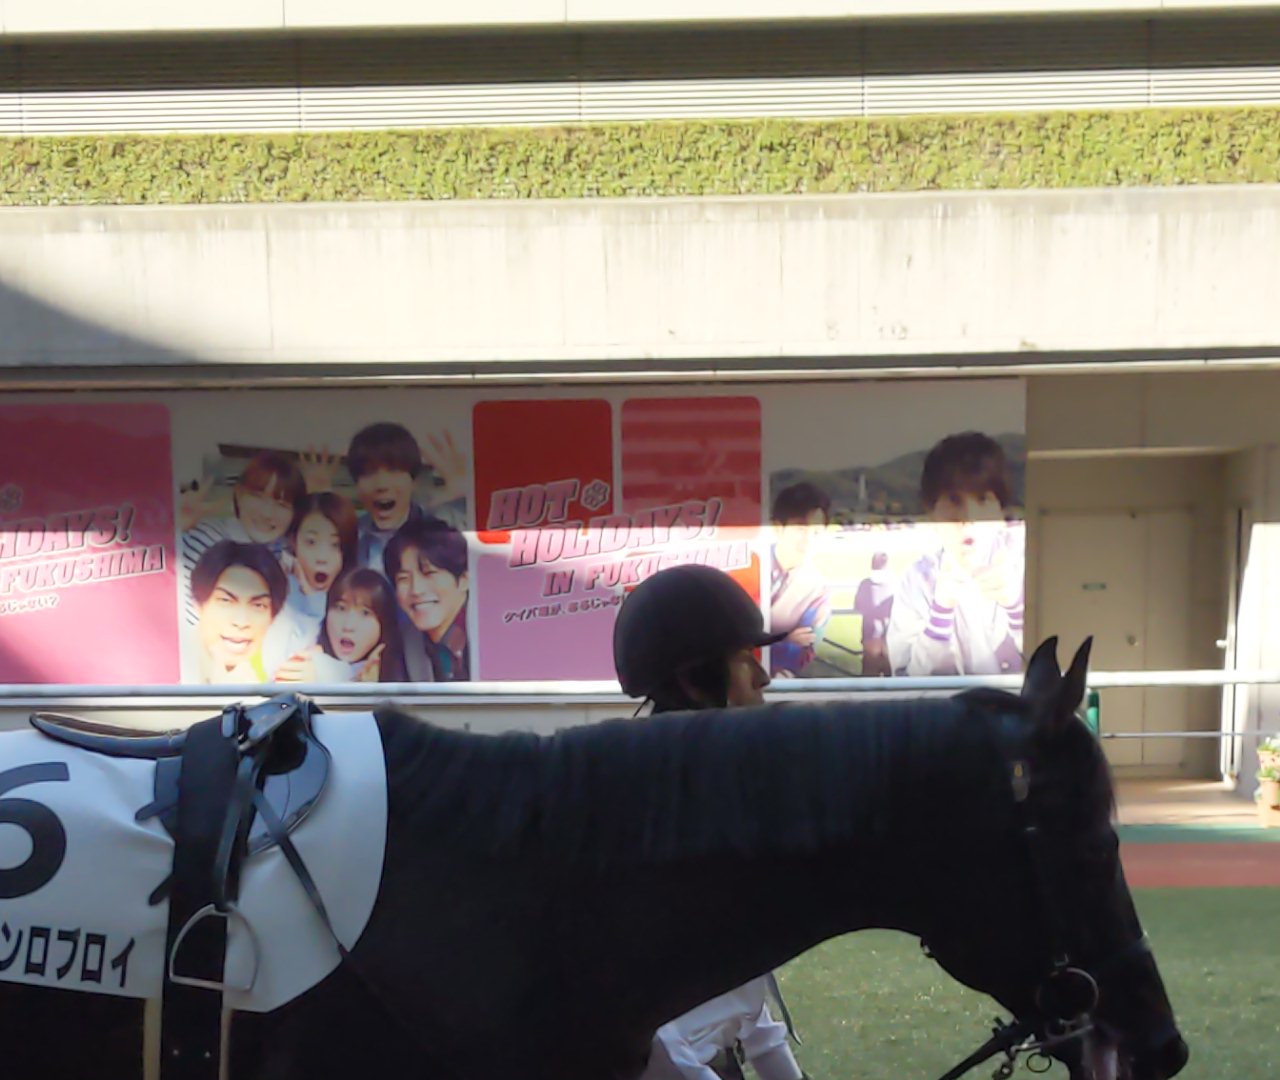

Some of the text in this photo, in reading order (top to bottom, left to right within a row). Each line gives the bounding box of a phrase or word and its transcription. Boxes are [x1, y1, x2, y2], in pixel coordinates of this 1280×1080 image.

[488, 480, 578, 530] HOT
[510, 500, 721, 567] HOLIDAYS!
[0, 546, 165, 594] FUKUSHIMA
[542, 570, 574, 597] IN
